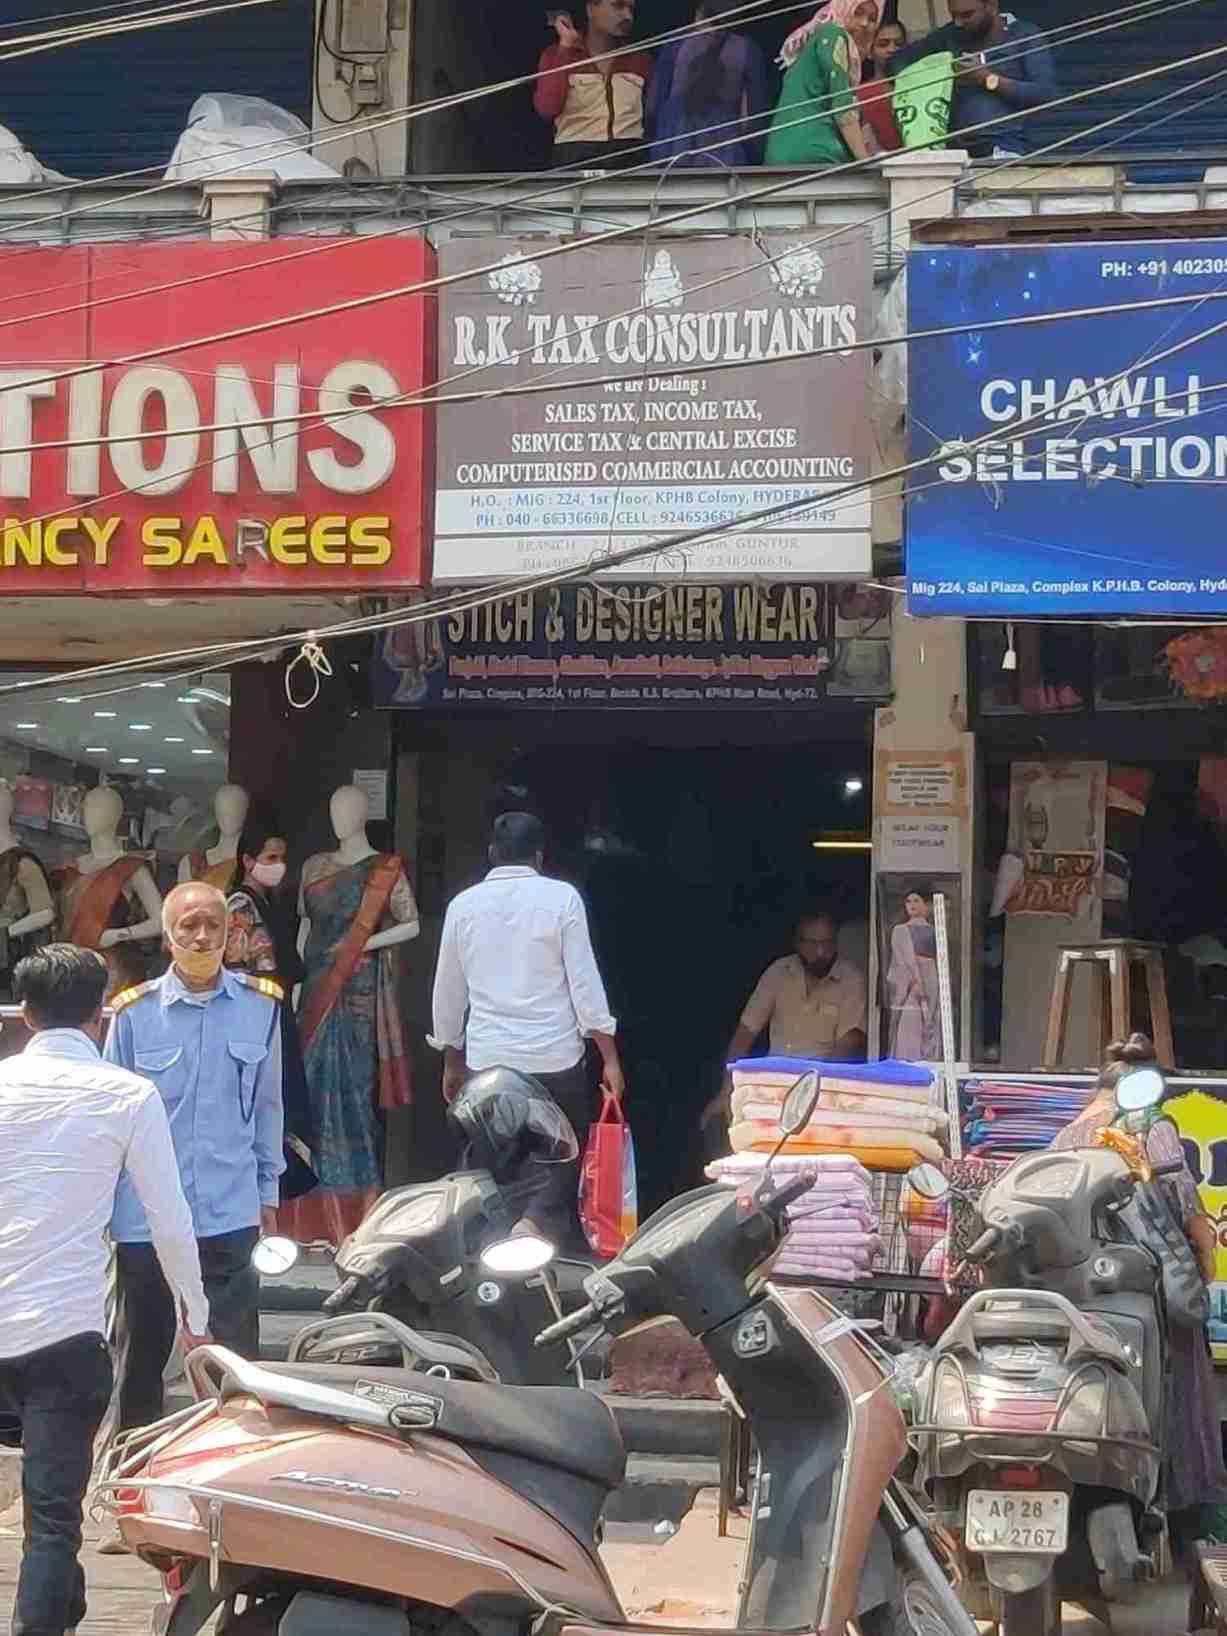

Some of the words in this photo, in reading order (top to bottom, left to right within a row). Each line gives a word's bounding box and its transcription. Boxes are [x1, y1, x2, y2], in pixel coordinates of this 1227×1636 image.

[1101, 261, 1133, 277] PH:
[1137, 260, 1168, 275] +91
[1172, 258, 1227, 275] 40230
[454, 315, 520, 366] R.K.
[528, 314, 599, 365] TAX
[605, 304, 857, 363] CONSULTANTS
[980, 374, 1200, 421] CHAWLI
[545, 403, 597, 423] SALES
[600, 402, 640, 424] TAX,
[644, 401, 719, 422] INCOME
[723, 400, 762, 422] TAX,
[0, 359, 400, 499] TIONS
[512, 432, 584, 453] SERVICE
[588, 432, 623, 451] TAX
[629, 433, 641, 450] &
[646, 430, 730, 450] CENTRAL
[734, 428, 797, 448] EXCISE
[456, 463, 597, 484] COMPUTERISED
[602, 460, 726, 481] COMMERCIAL
[728, 457, 854, 480] ACCOUNTING
[515, 493, 544, 506] MIG
[656, 491, 694, 505] KPHB
[698, 490, 749, 506] Colony,
[476, 513, 495, 526] PH
[506, 513, 530, 526] 040
[616, 511, 649, 525] CELL
[0, 516, 121, 566] NCY
[142, 515, 392, 567] SAREES
[1032, 580, 1088, 596] Complex
[545, 586, 564, 642] &
[576, 586, 724, 642] DESIGNER
[734, 585, 819, 642] WEAR
[989, 1499, 1015, 1518] AP
[1021, 1500, 1043, 1518] 28
[1009, 1528, 1057, 1547] 2767
